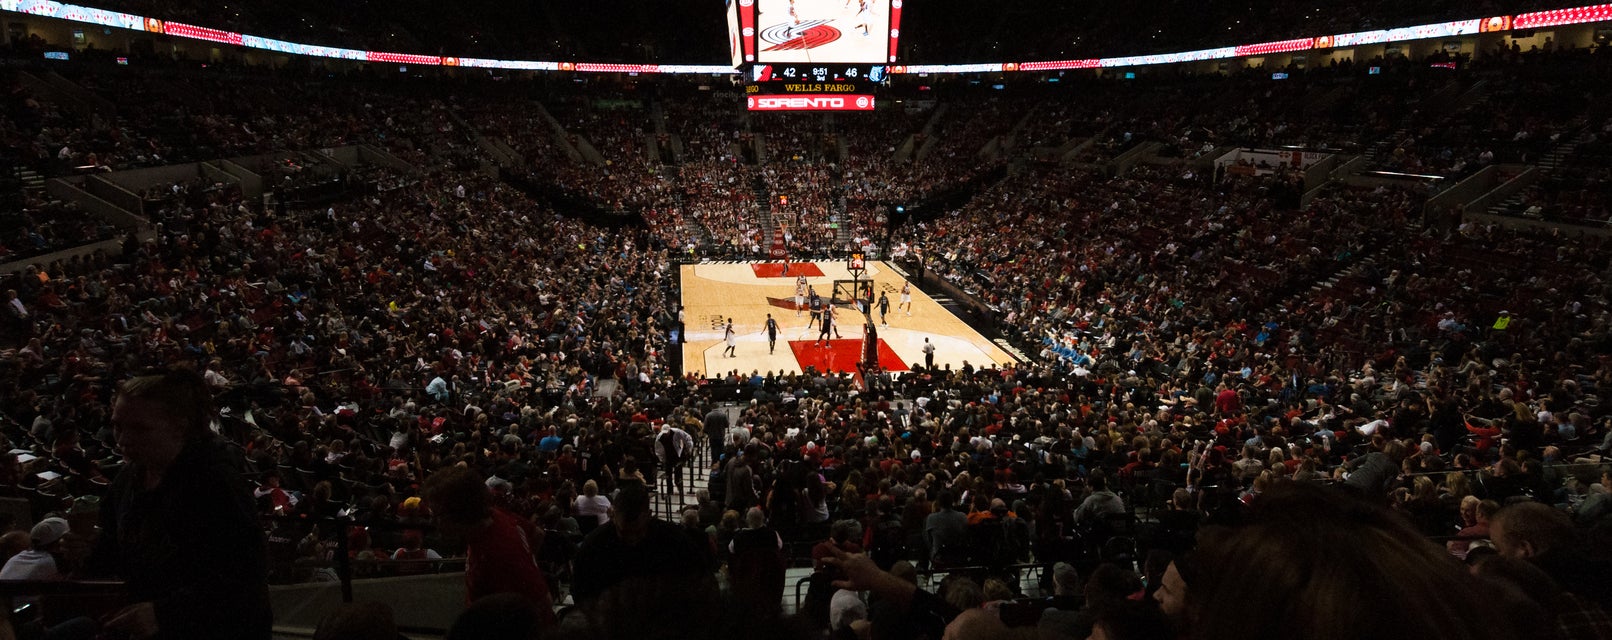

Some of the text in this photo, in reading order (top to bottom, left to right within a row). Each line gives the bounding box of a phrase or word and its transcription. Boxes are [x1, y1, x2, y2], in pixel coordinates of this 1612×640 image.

[783, 67, 796, 78] 42
[812, 67, 828, 76] 9:51
[845, 67, 858, 78] 46
[784, 83, 856, 92] WELLS FARGO
[758, 97, 844, 108] SORENTO
